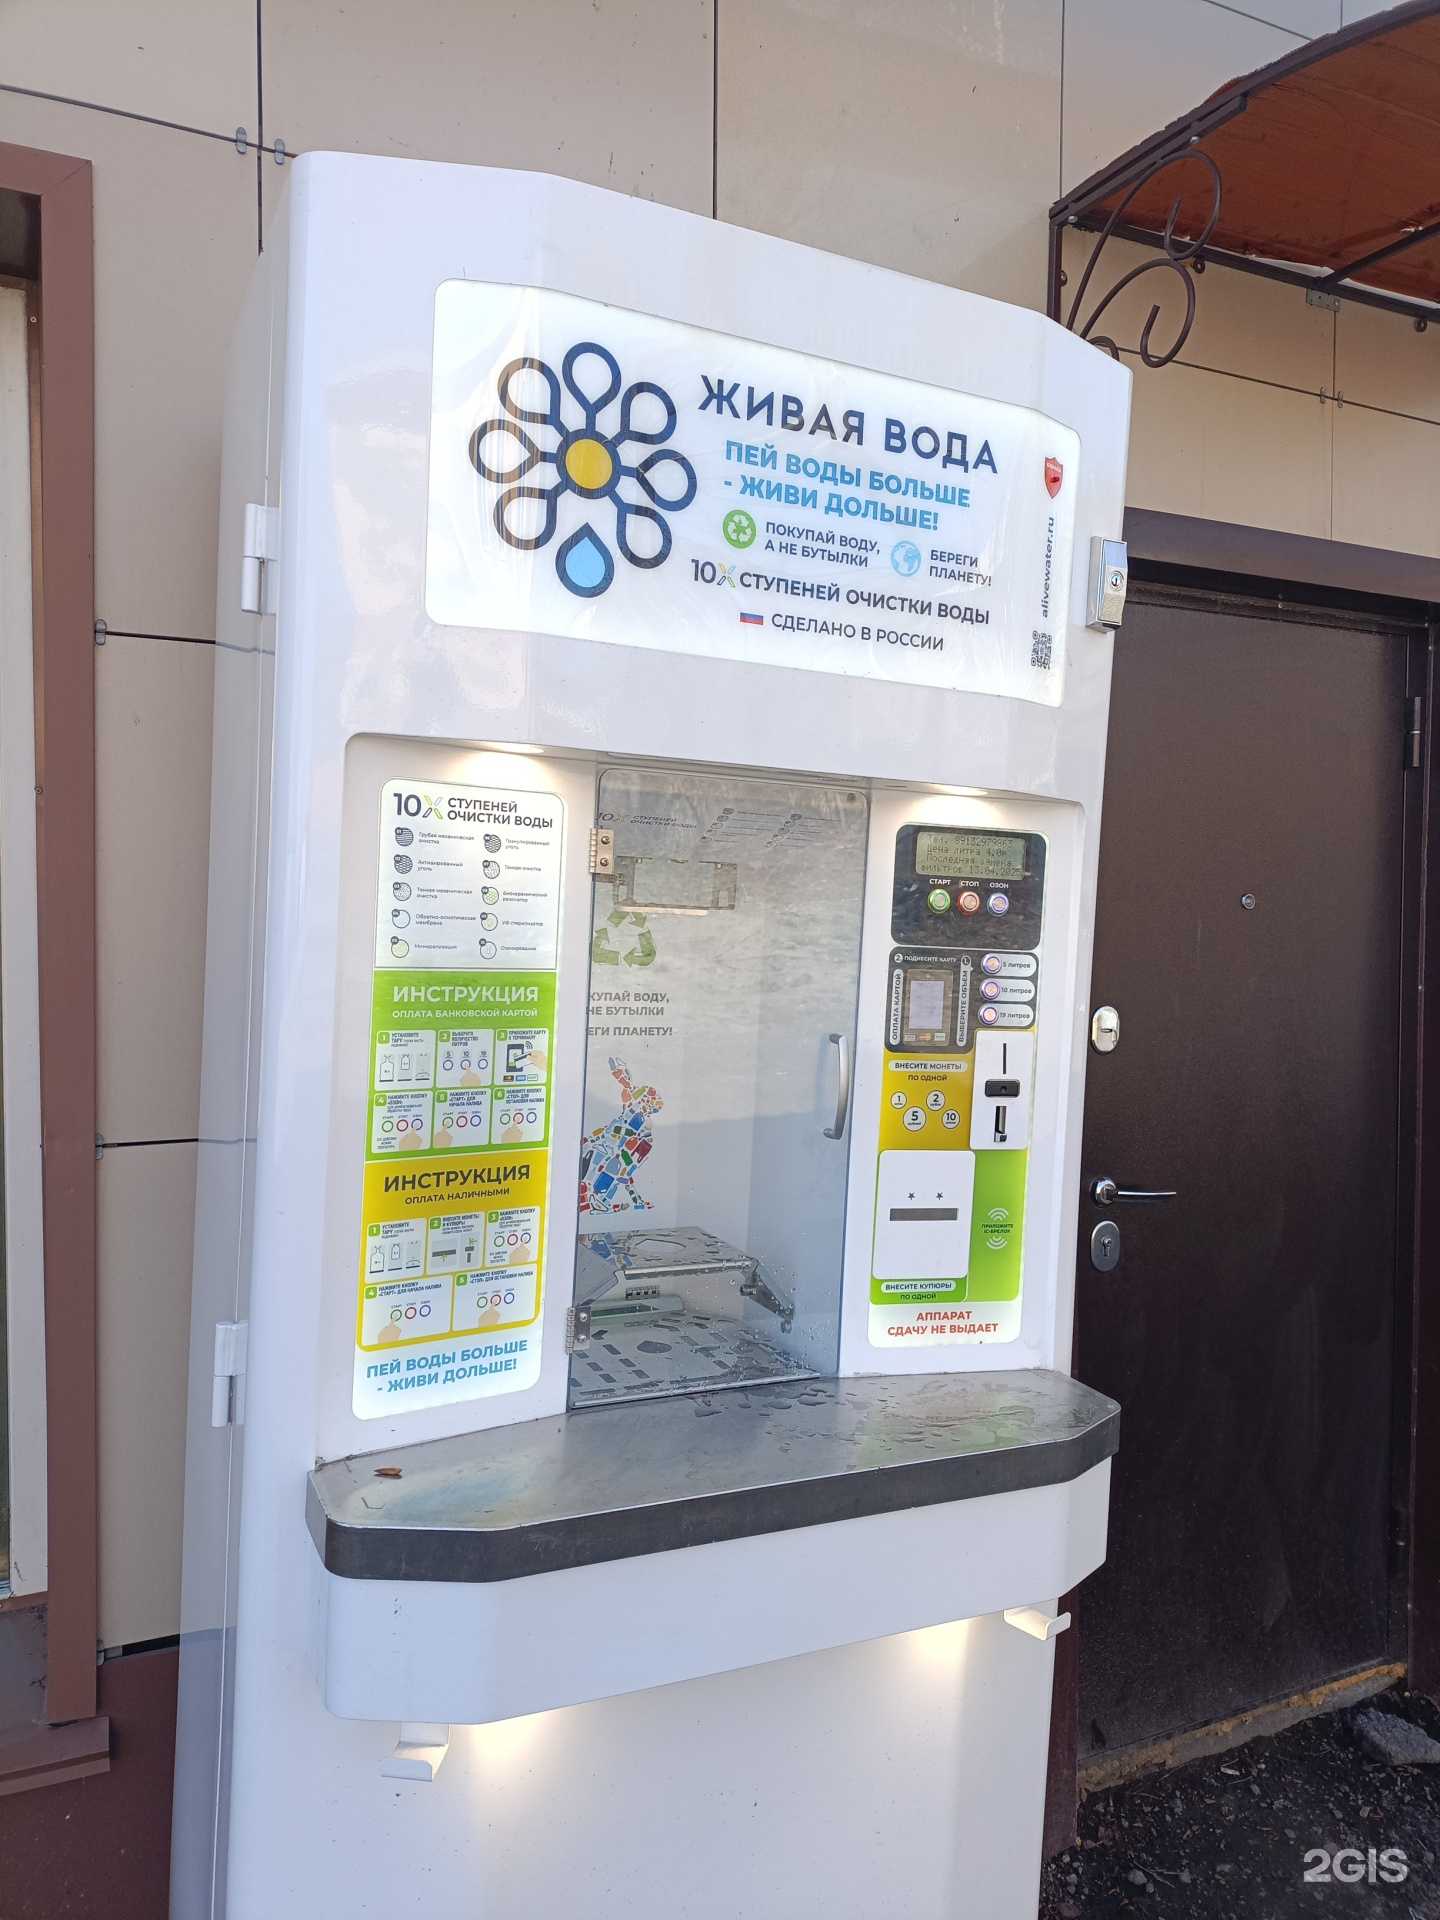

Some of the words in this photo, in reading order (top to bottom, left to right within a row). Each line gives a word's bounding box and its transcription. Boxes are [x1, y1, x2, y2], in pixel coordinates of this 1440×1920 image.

[698, 374, 865, 446] ЖИВАЯ
[884, 417, 998, 474] ВОДА
[725, 440, 778, 470] ПЕЙ
[786, 453, 862, 487] ВОДЫ
[869, 470, 971, 508] БОЛЬШЕ
[740, 474, 818, 509] ЖИВИ
[824, 494, 939, 531] ДОЛЬШЕ!
[765, 521, 835, 546] ПОКУПАЙ
[839, 534, 880, 555] ВОДУ,
[764, 539, 776, 553] А
[779, 541, 798, 556] НЕ
[801, 545, 868, 568] БУТЫЛКИ
[930, 549, 979, 568] БЕРЕГИ
[929, 565, 992, 587] ПЛАНЕТУ!
[1041, 516, 1055, 618] alivewater.ru
[739, 571, 841, 603] СТУПЕНЕЙ
[846, 588, 933, 616] ОЧИСТКИ
[937, 602, 990, 626] ВОДЫ
[771, 612, 856, 640] СДЕЛАНО
[860, 626, 872, 642] В
[876, 628, 945, 651] РОССИИ
[447, 797, 518, 815] СТУПЕНЕЙ
[447, 809, 511, 826] ОЧИСТКИ
[514, 815, 554, 829] ВОДЫ
[929, 878, 951, 886] СТАРТ
[960, 880, 980, 888] СТОП
[392, 986, 539, 1005] ИНСТРУКЦИЯ
[634, 992, 670, 1004] ВОДУ,
[894, 973, 902, 1006] КАРТОЙ
[392, 1009, 433, 1019] ОПЛАТА
[435, 1007, 500, 1018] БАНКОВСКОЙ
[501, 1008, 538, 1018] КАРТОЙ
[606, 1006, 664, 1016] БУТЫЛКИ
[613, 1026, 673, 1036] ПЛАНЕТУ!
[894, 1062, 928, 1070] ВНЕСИТЕ
[920, 1073, 948, 1082] ОДНОЙ
[932, 1093, 940, 1103] 2
[911, 1110, 919, 1121] 5
[945, 1112, 957, 1121] 10
[384, 1164, 531, 1193] ИНСТРУКЦИЯ
[404, 1193, 445, 1205] ОПЛАТА
[446, 1187, 511, 1201] НАЛИЧНЫМИ
[885, 1283, 918, 1291] ВНЕСИТЕ
[919, 1282, 952, 1290] КУПЮРЫ
[911, 1293, 937, 1301] ОДНОЙ
[916, 1310, 973, 1322] АППАРАТ
[887, 1325, 928, 1337] СДАЧУ
[930, 1326, 946, 1334] НЕ
[949, 1323, 999, 1335] ВЫДАЕТ
[366, 1358, 402, 1379] ПЕЙ
[405, 1350, 456, 1371] ВОДЫ
[460, 1339, 528, 1363] БОЛЬШЕ
[387, 1371, 439, 1393] ЖИВИ
[442, 1357, 517, 1385] ДОЛЬШЕ!
